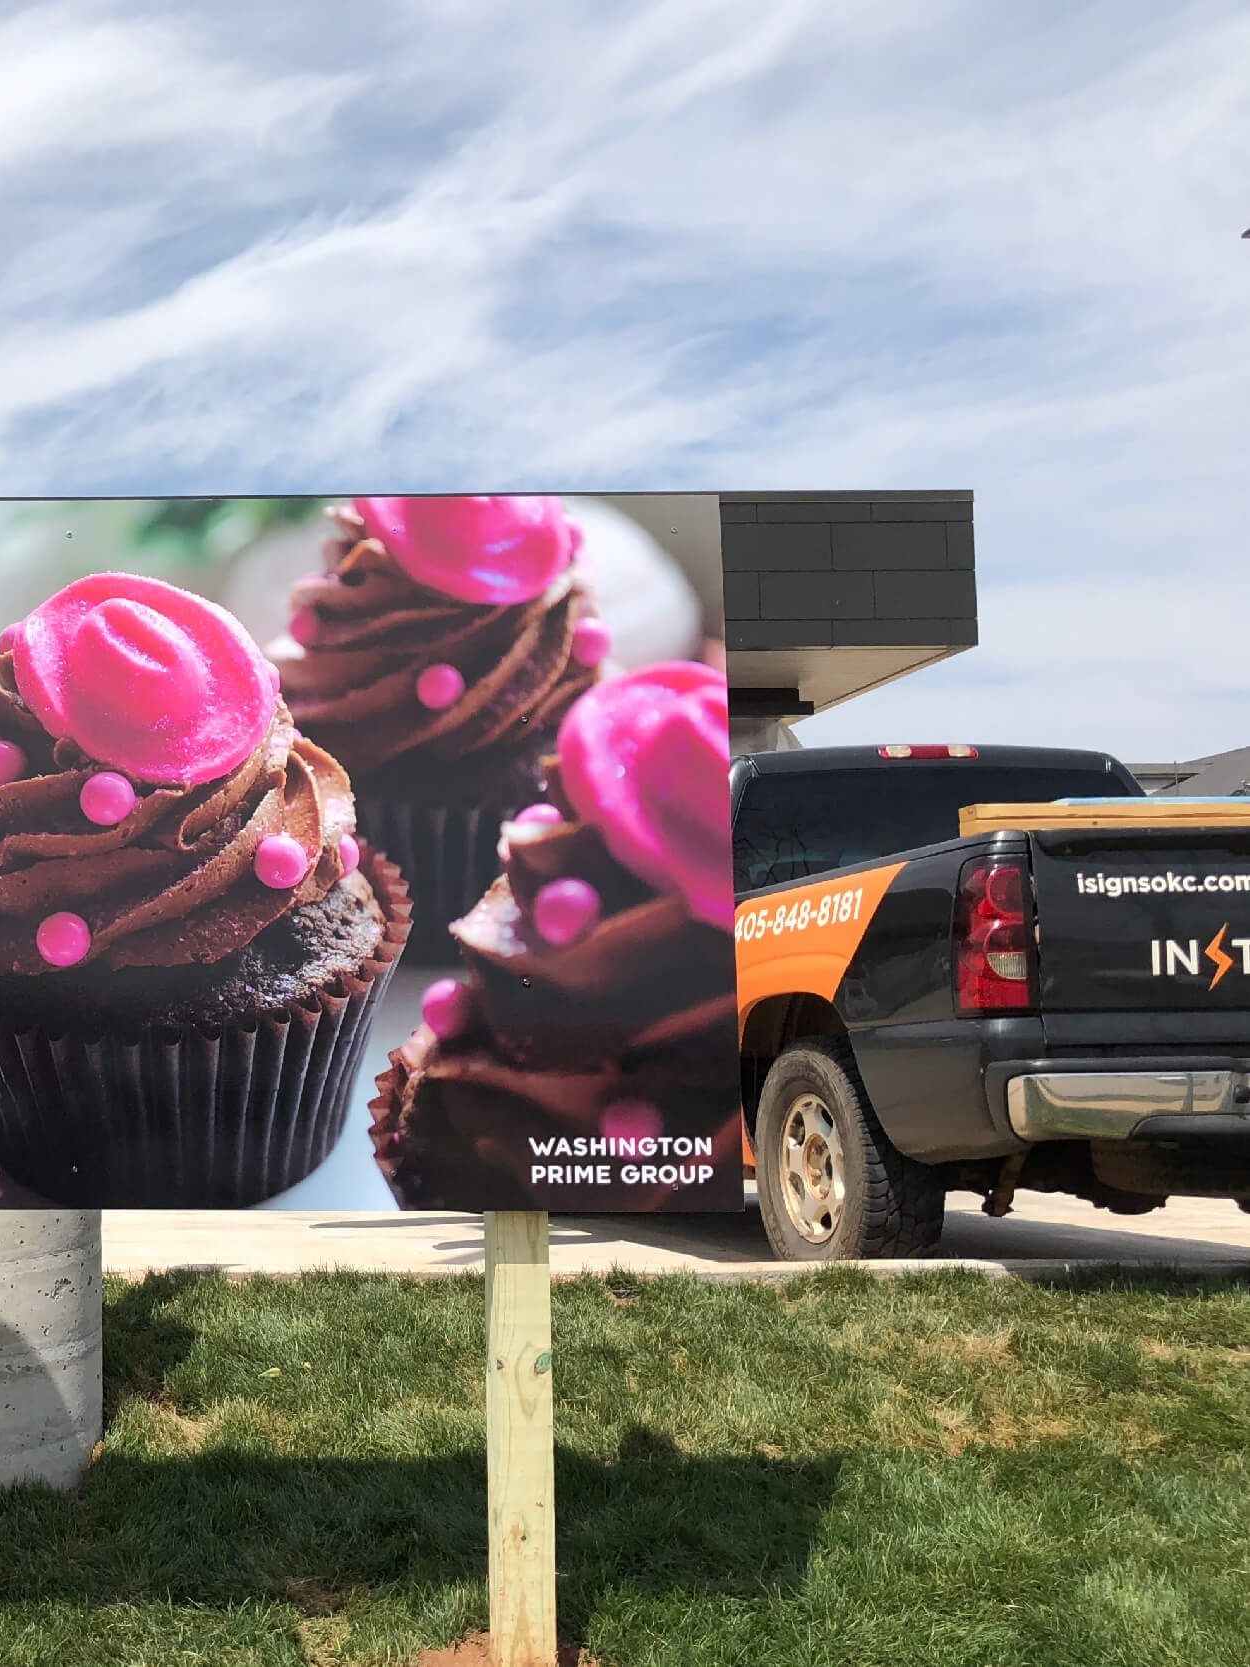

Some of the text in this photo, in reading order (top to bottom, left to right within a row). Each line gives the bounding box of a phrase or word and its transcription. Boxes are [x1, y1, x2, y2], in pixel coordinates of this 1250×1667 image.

[734, 887, 863, 943] 405-848-8181
[528, 1137, 712, 1157] WASHINGTON
[531, 1165, 714, 1185] PRIME GROUP
